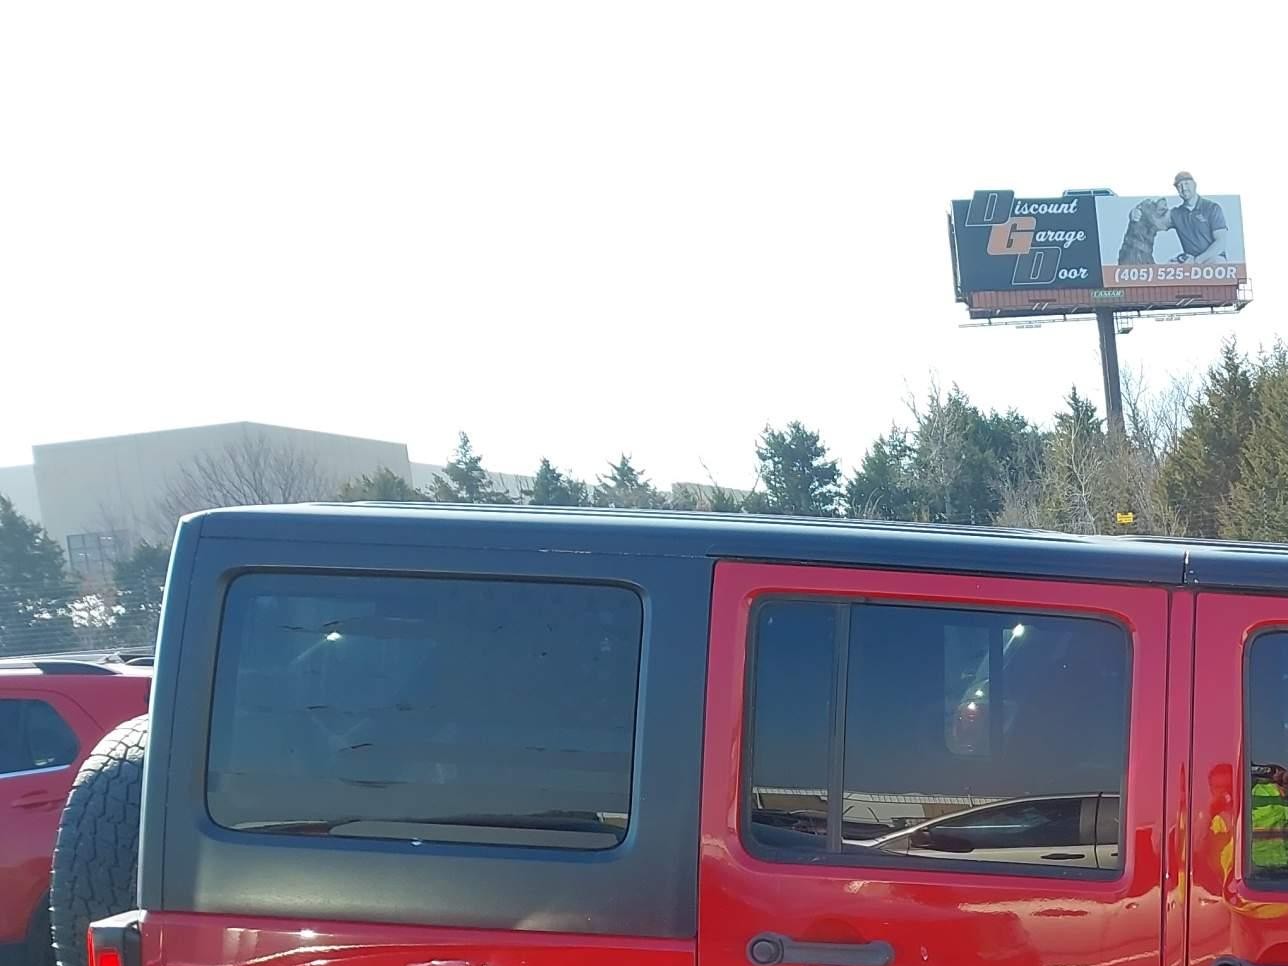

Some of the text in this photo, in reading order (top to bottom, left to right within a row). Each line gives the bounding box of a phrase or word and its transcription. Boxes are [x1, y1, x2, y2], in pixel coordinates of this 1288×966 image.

[965, 190, 1079, 227] Discount
[987, 217, 1086, 256] Garage
[1012, 246, 1089, 285] Door
[1114, 266, 1238, 283] (405) 525-DOOR
